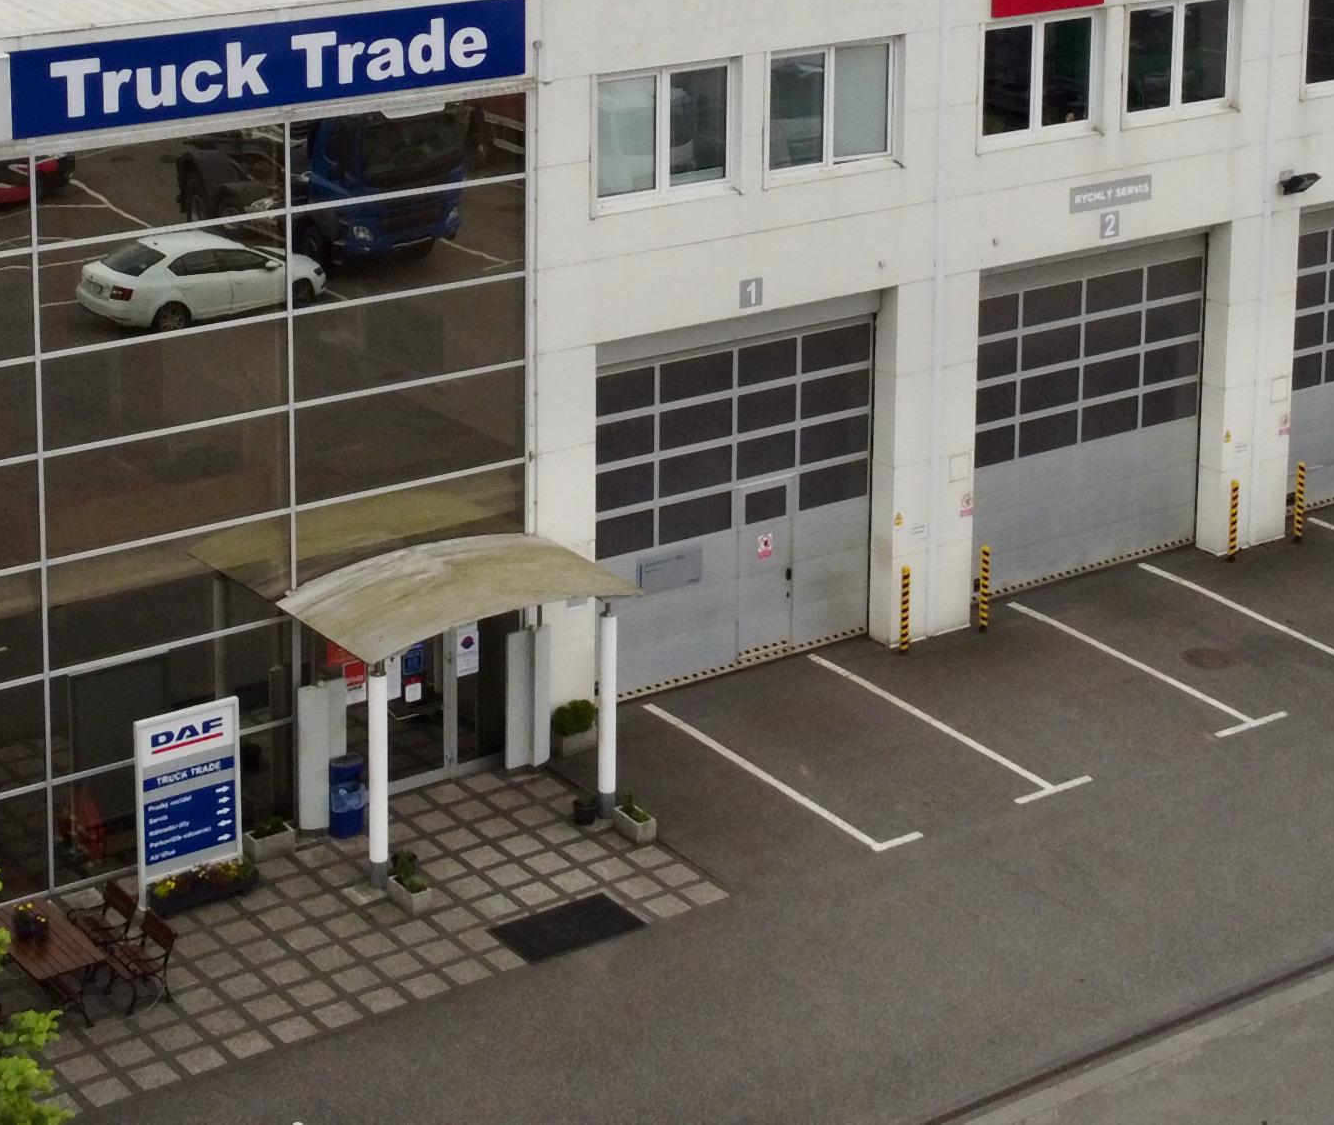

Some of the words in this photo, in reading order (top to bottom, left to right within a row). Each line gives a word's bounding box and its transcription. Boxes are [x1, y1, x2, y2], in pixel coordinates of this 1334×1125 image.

[49, 41, 270, 119] Truck
[290, 17, 489, 89] Trade
[1115, 182, 1150, 198] SERVIS
[1103, 213, 1116, 237] 2
[746, 280, 756, 305] 1
[150, 716, 223, 748] DAF
[156, 770, 188, 787] TRUCK
[190, 761, 221, 777] TRADE
